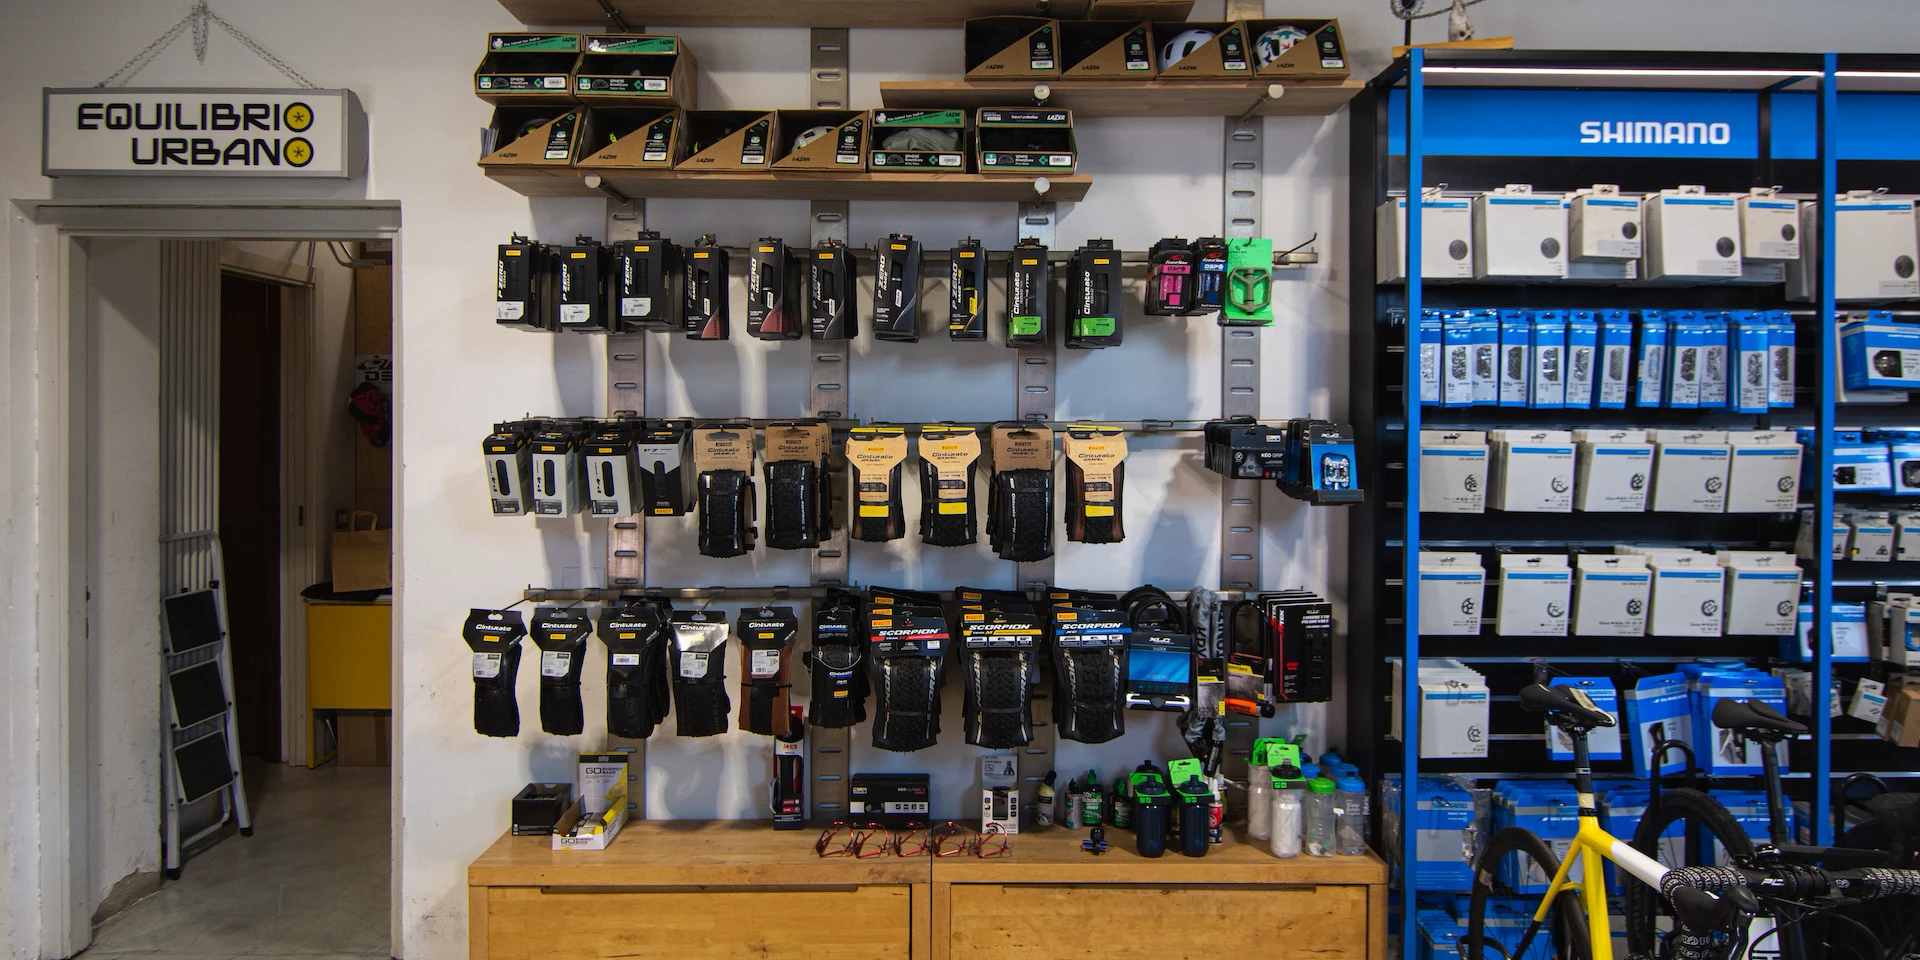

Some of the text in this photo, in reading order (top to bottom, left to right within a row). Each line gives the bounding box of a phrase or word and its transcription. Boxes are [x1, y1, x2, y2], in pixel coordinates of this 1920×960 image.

[78, 102, 313, 132] EQUILIBRIO
[1580, 122, 1730, 144] SHIMANO
[131, 137, 313, 167] URBANO
[750, 293, 756, 302] P
[878, 289, 883, 299] P
[952, 302, 957, 310] P
[475, 624, 512, 632] Cinturato
[879, 628, 939, 636] SCORPION
